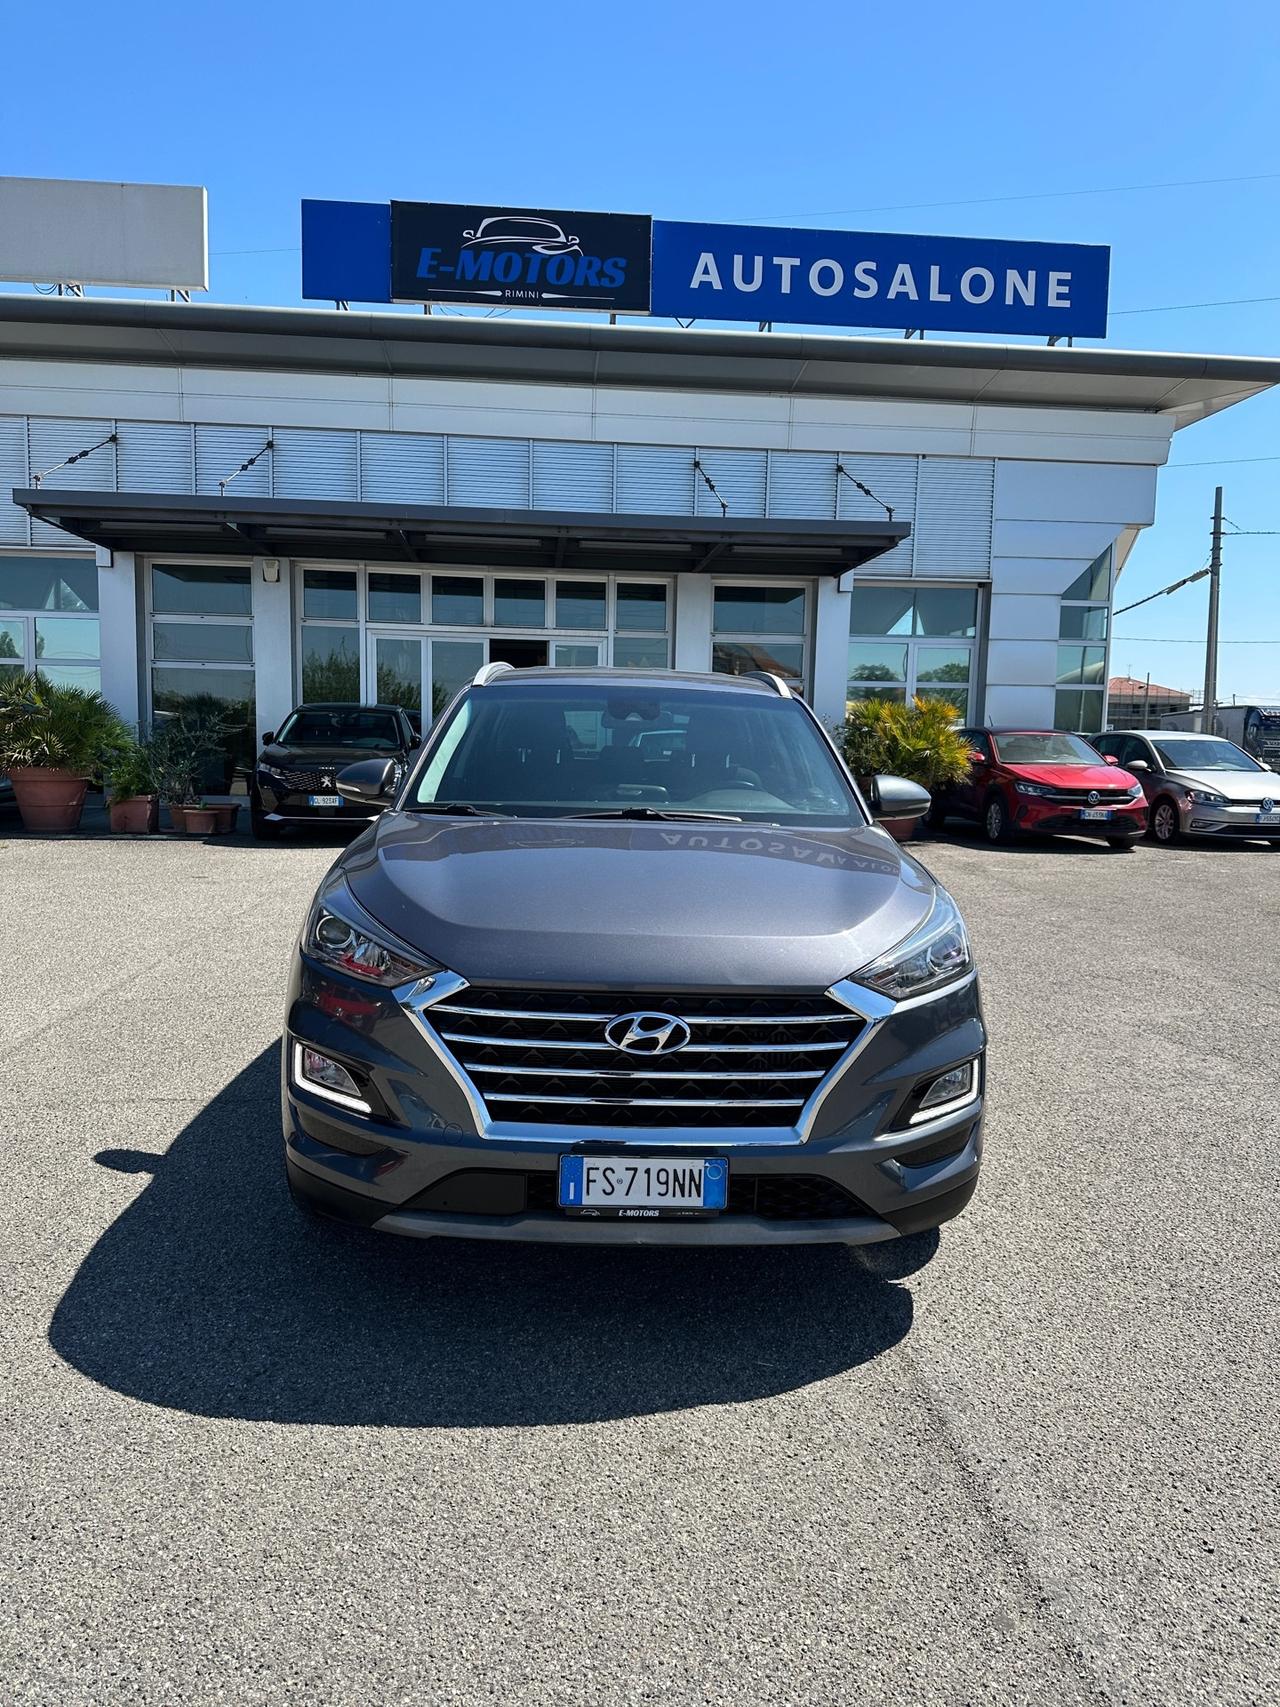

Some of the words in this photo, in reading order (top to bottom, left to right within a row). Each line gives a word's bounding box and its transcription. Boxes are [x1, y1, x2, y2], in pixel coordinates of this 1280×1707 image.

[416, 247, 628, 288] E-MOTORS
[689, 252, 1073, 308] AUTOSALONE
[504, 289, 539, 299] RIMINI
[618, 1209, 660, 1217] E-MOTORS
